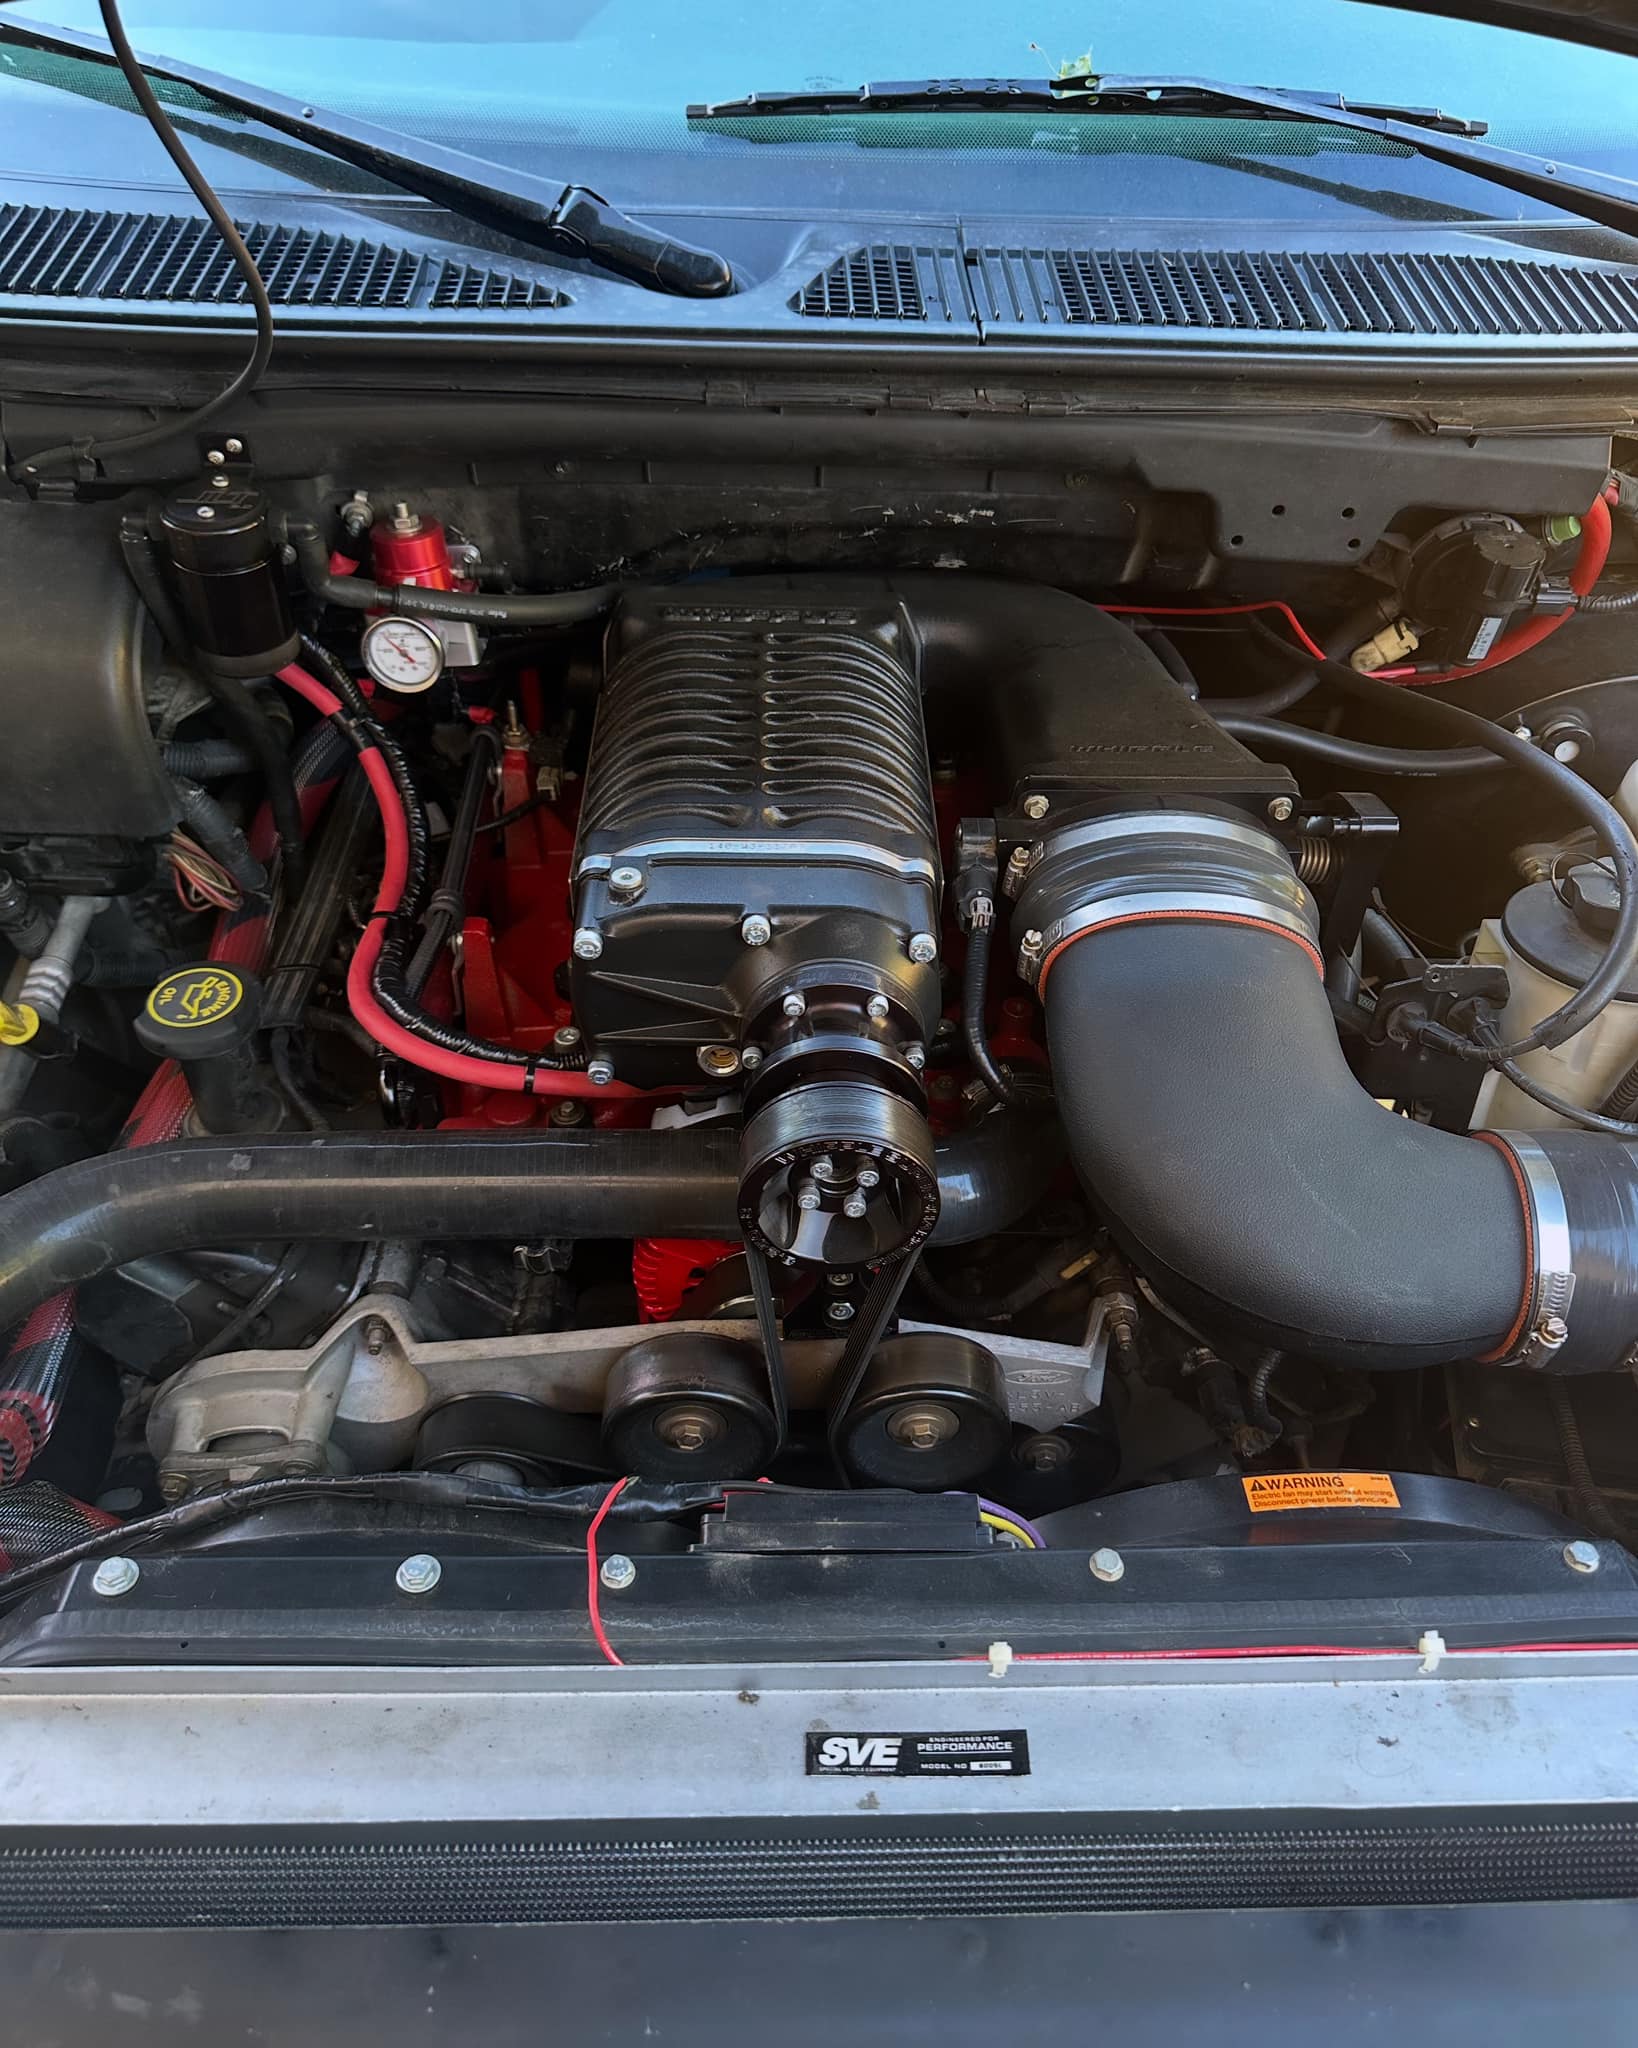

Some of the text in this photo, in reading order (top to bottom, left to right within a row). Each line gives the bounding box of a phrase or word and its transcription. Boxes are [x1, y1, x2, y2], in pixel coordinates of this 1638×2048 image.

[158, 987, 177, 1005] OIL
[199, 980, 231, 1017] ENGINE
[1265, 1476, 1344, 1490] WARNING
[1252, 1491, 1281, 1500] Electric
[1283, 1490, 1296, 1498] fan
[1254, 1499, 1298, 1508] Disconnect
[818, 1737, 902, 1766] SVE
[917, 1741, 1013, 1751] PERFORMANCE
